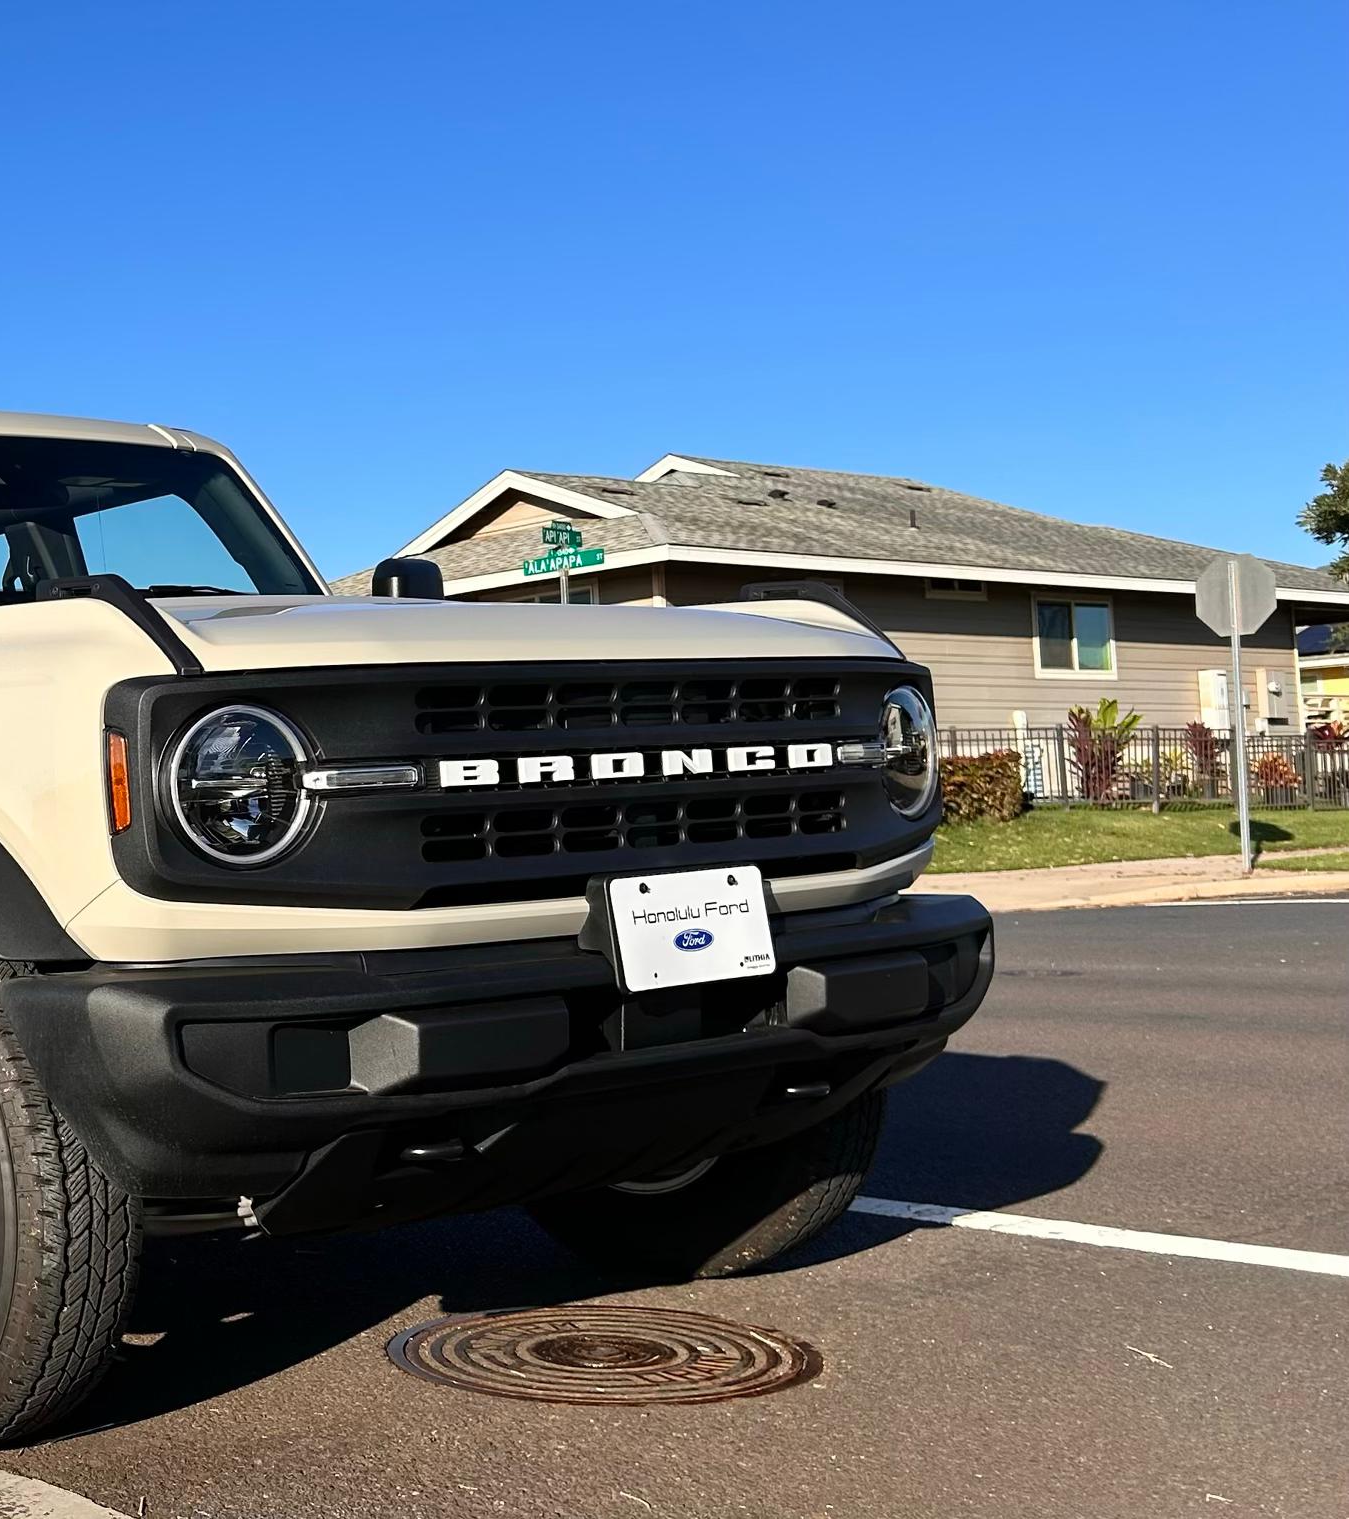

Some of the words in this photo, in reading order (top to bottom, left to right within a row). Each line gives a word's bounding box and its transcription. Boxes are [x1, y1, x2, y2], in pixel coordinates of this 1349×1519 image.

[439, 743, 833, 788] BRONCO
[632, 905, 701, 925] Honolulu
[704, 899, 750, 917] Ford
[682, 931, 706, 947] Ford
